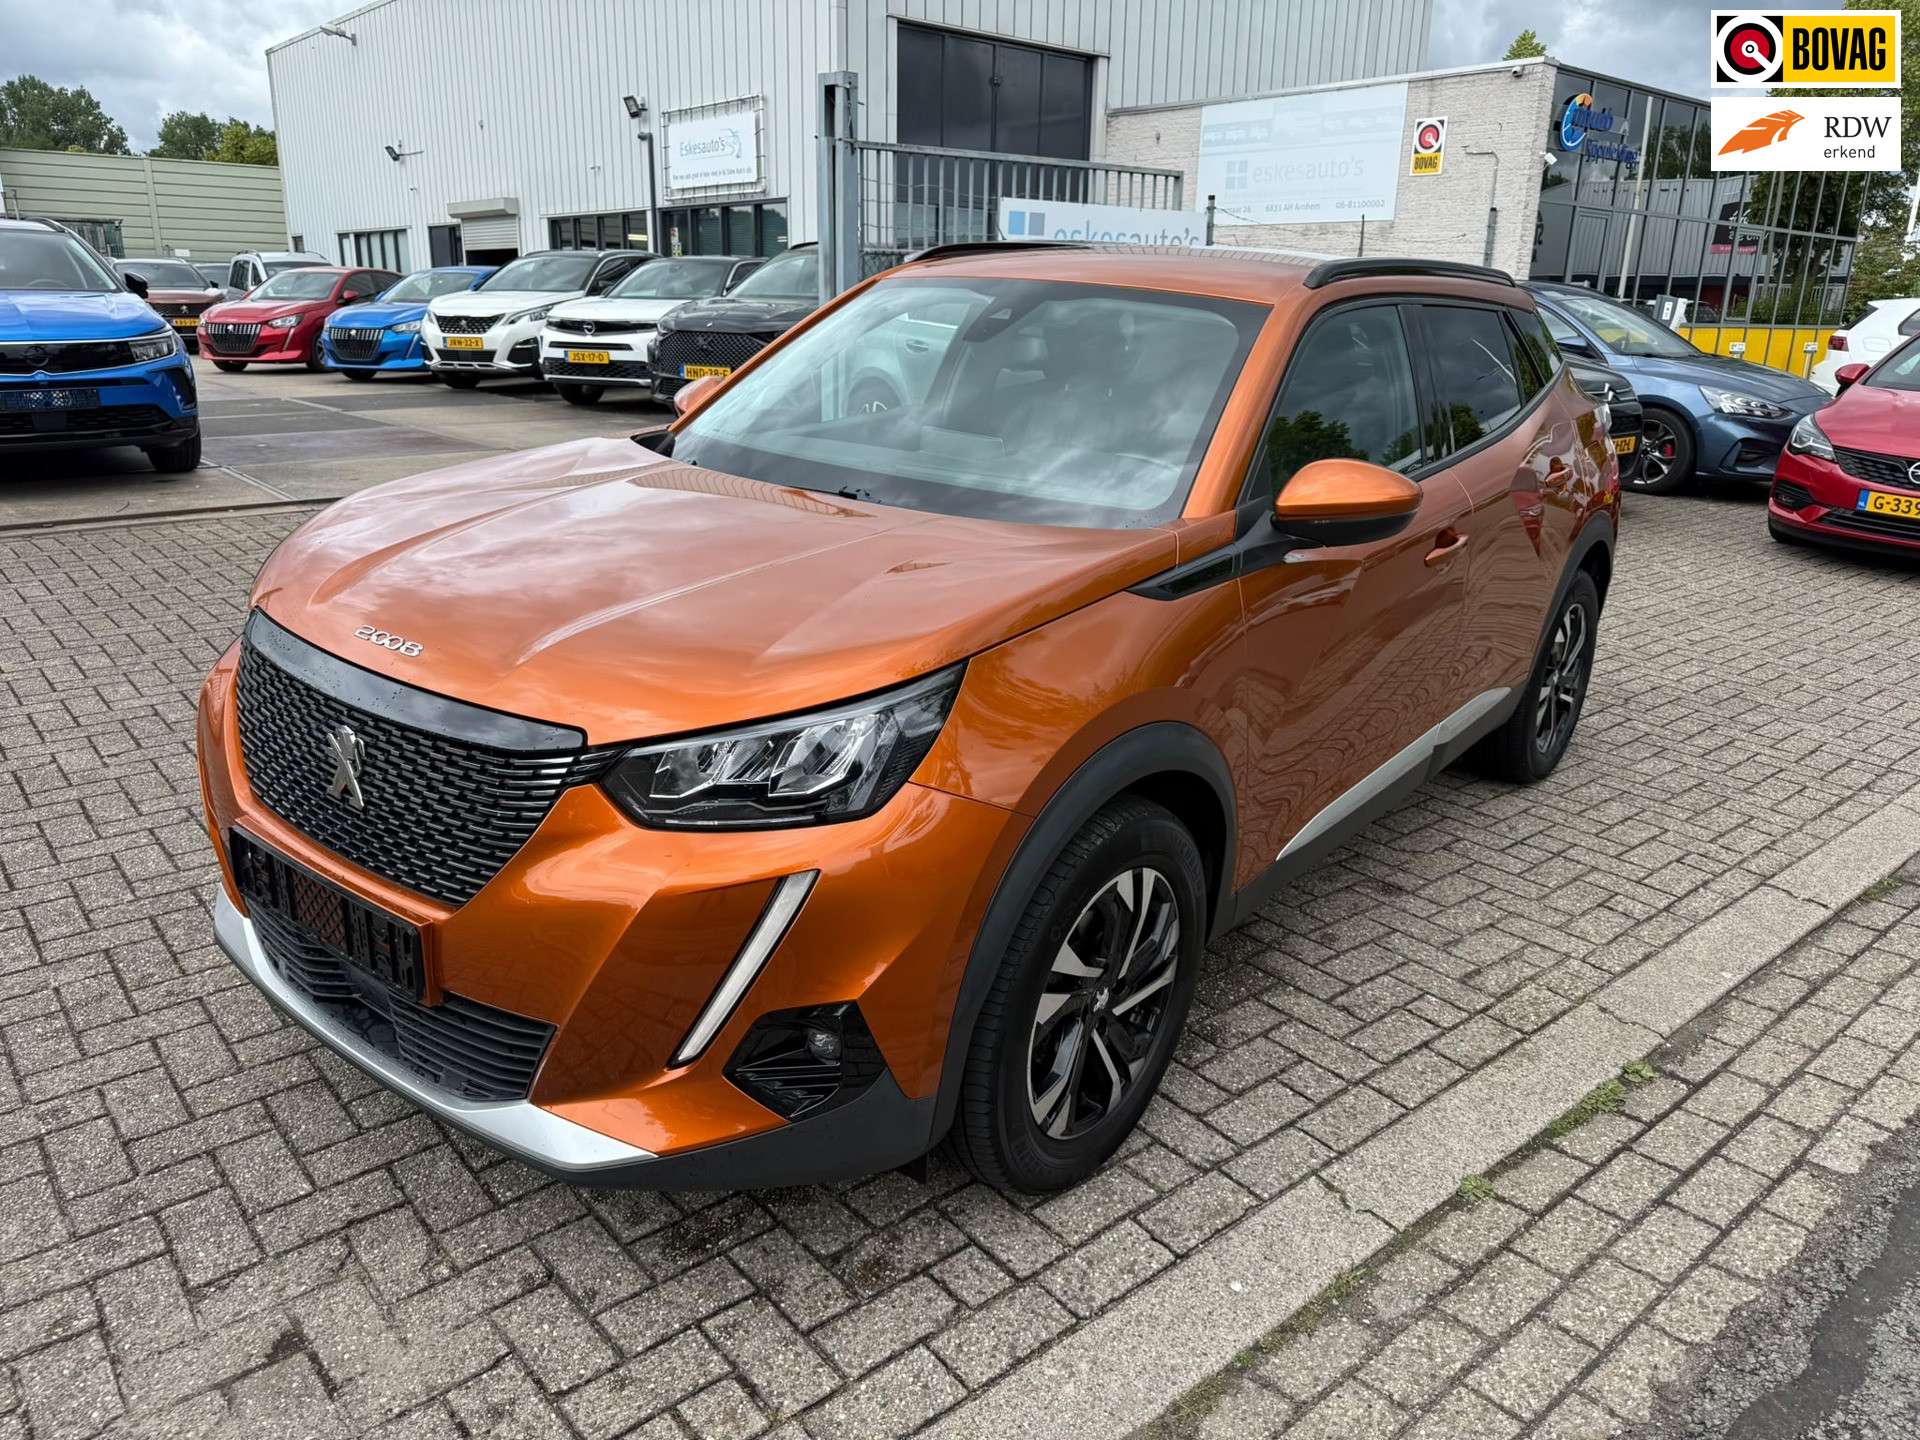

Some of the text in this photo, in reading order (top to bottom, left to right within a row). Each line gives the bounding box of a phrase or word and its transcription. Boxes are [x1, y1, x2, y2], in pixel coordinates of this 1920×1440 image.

[1252, 155, 1366, 184] eskesauto's
[1414, 156, 1439, 170] BOVAG
[354, 624, 424, 657] 2008
